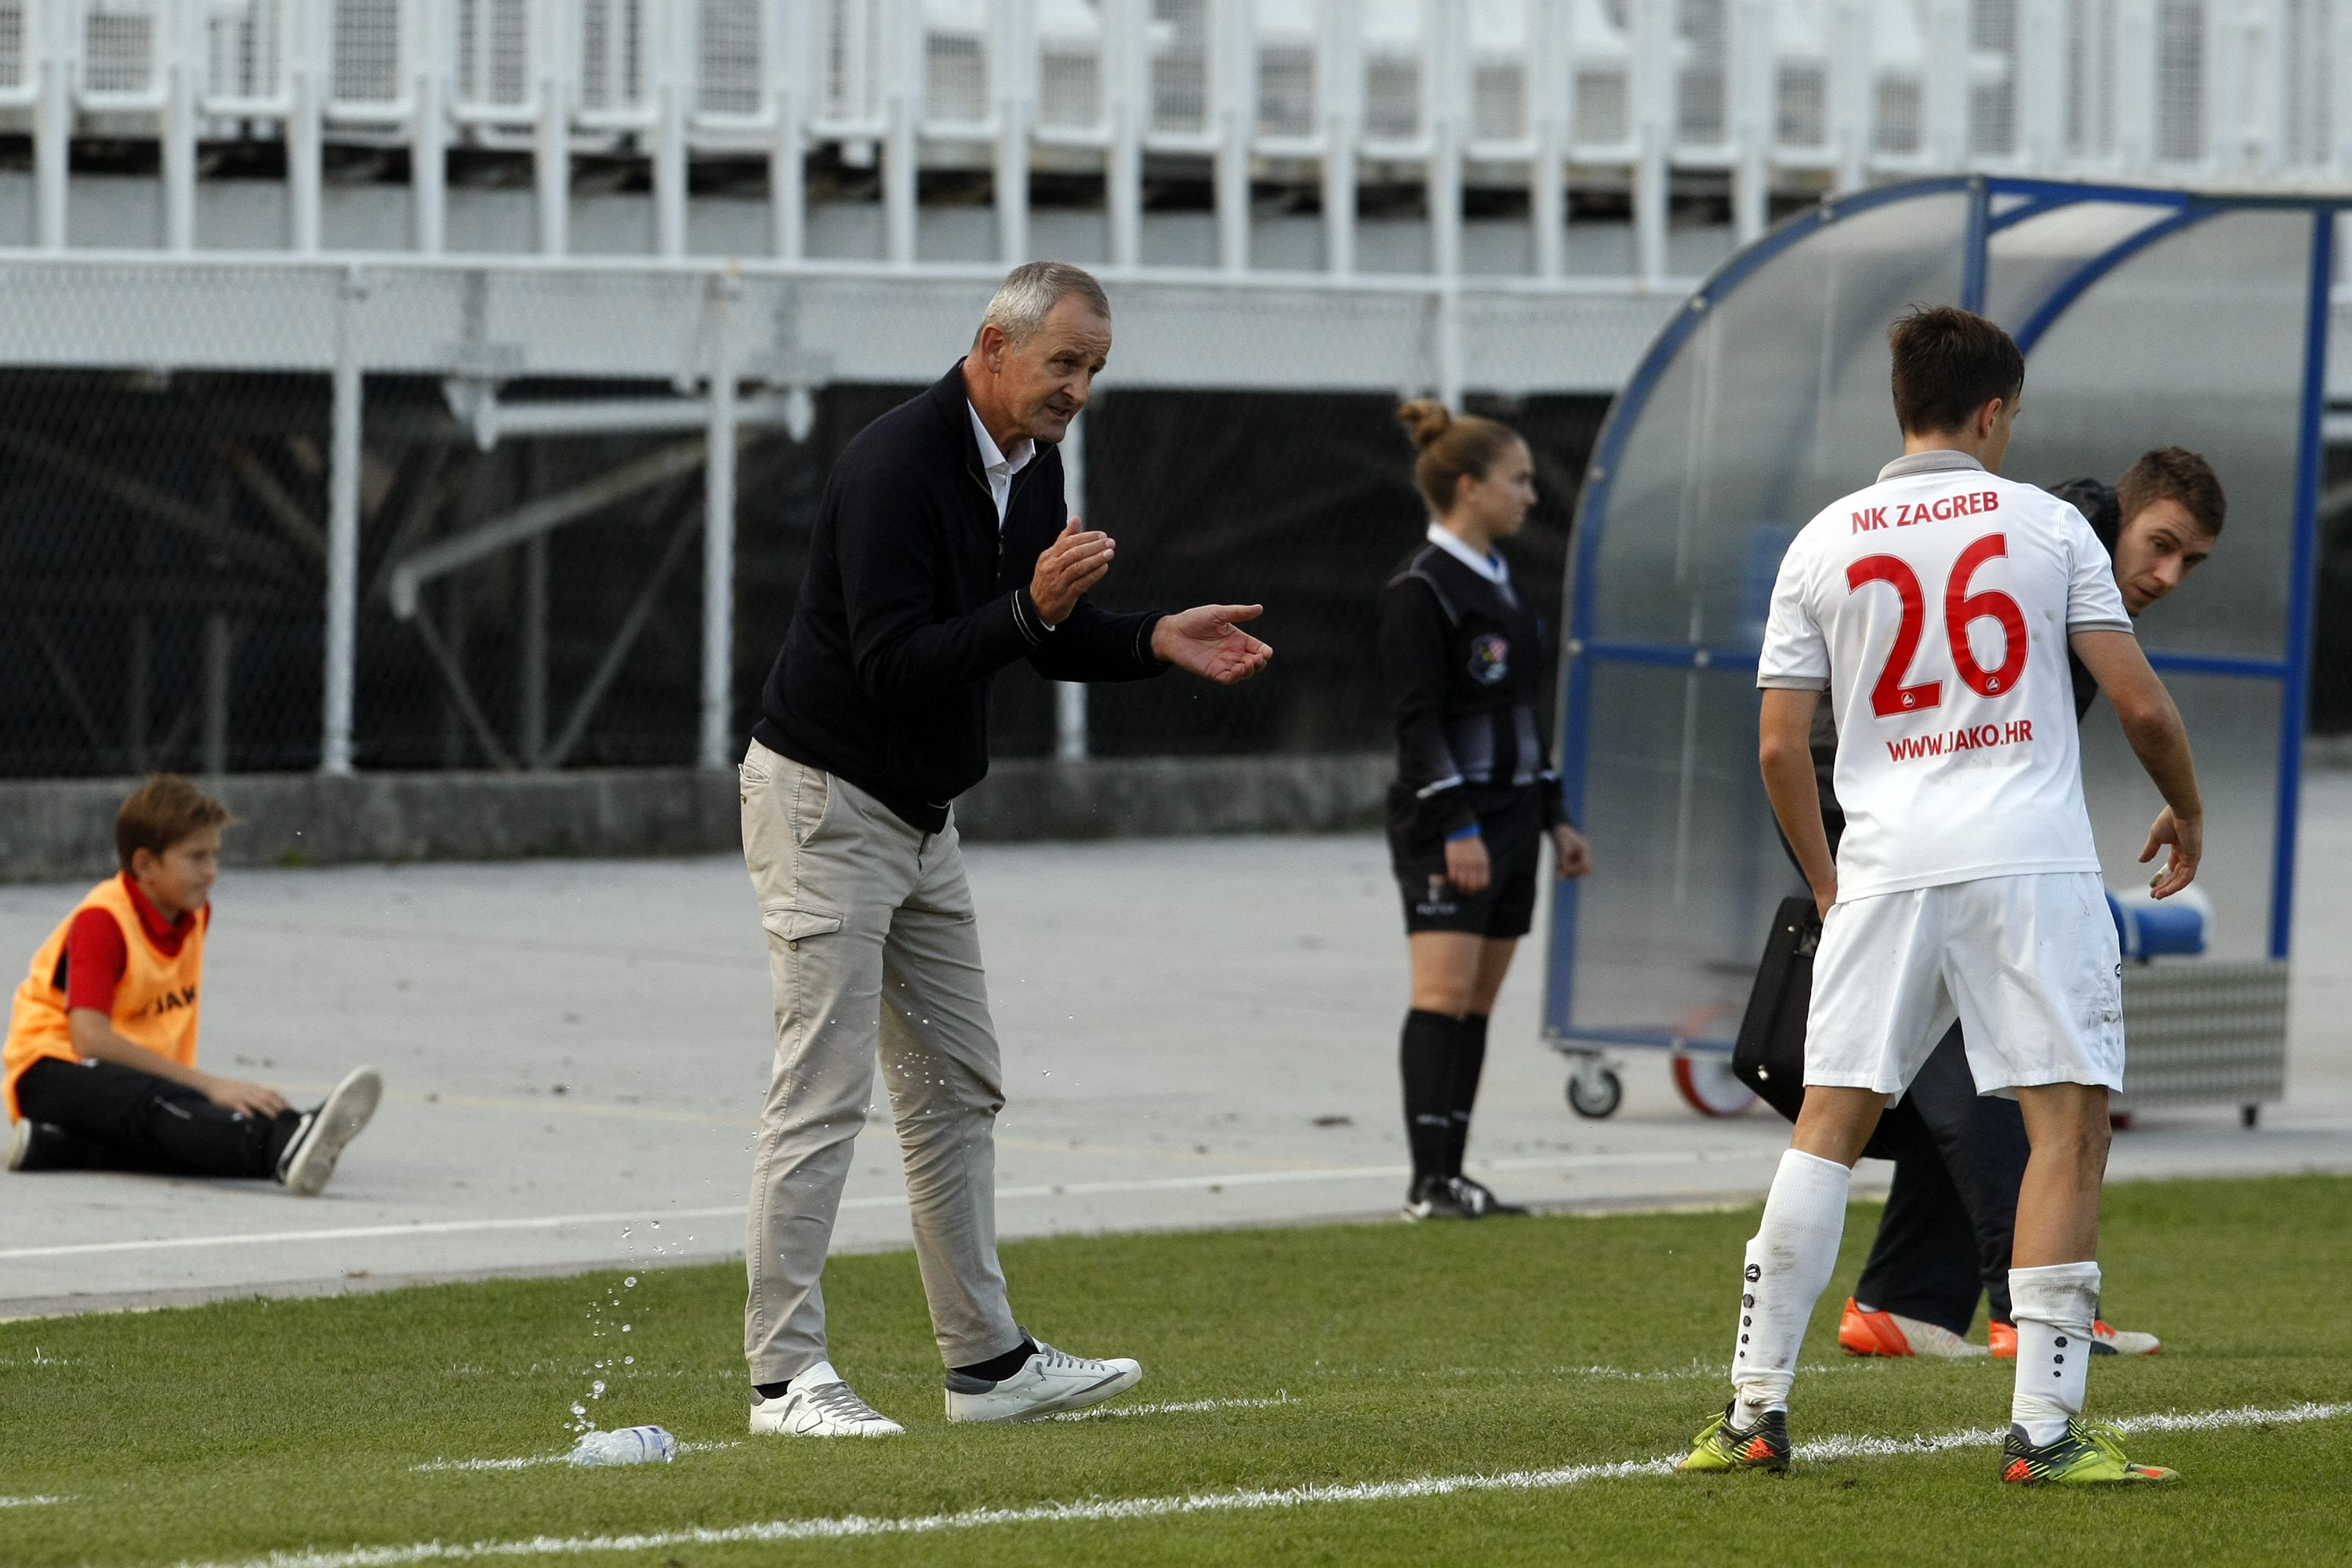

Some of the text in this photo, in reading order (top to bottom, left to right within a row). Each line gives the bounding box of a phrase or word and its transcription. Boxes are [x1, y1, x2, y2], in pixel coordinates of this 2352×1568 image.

[1851, 491, 1999, 535] NK ZAGREB
[1845, 532, 2030, 719] 26
[1886, 719, 2034, 761] WWW.JAKO.HR
